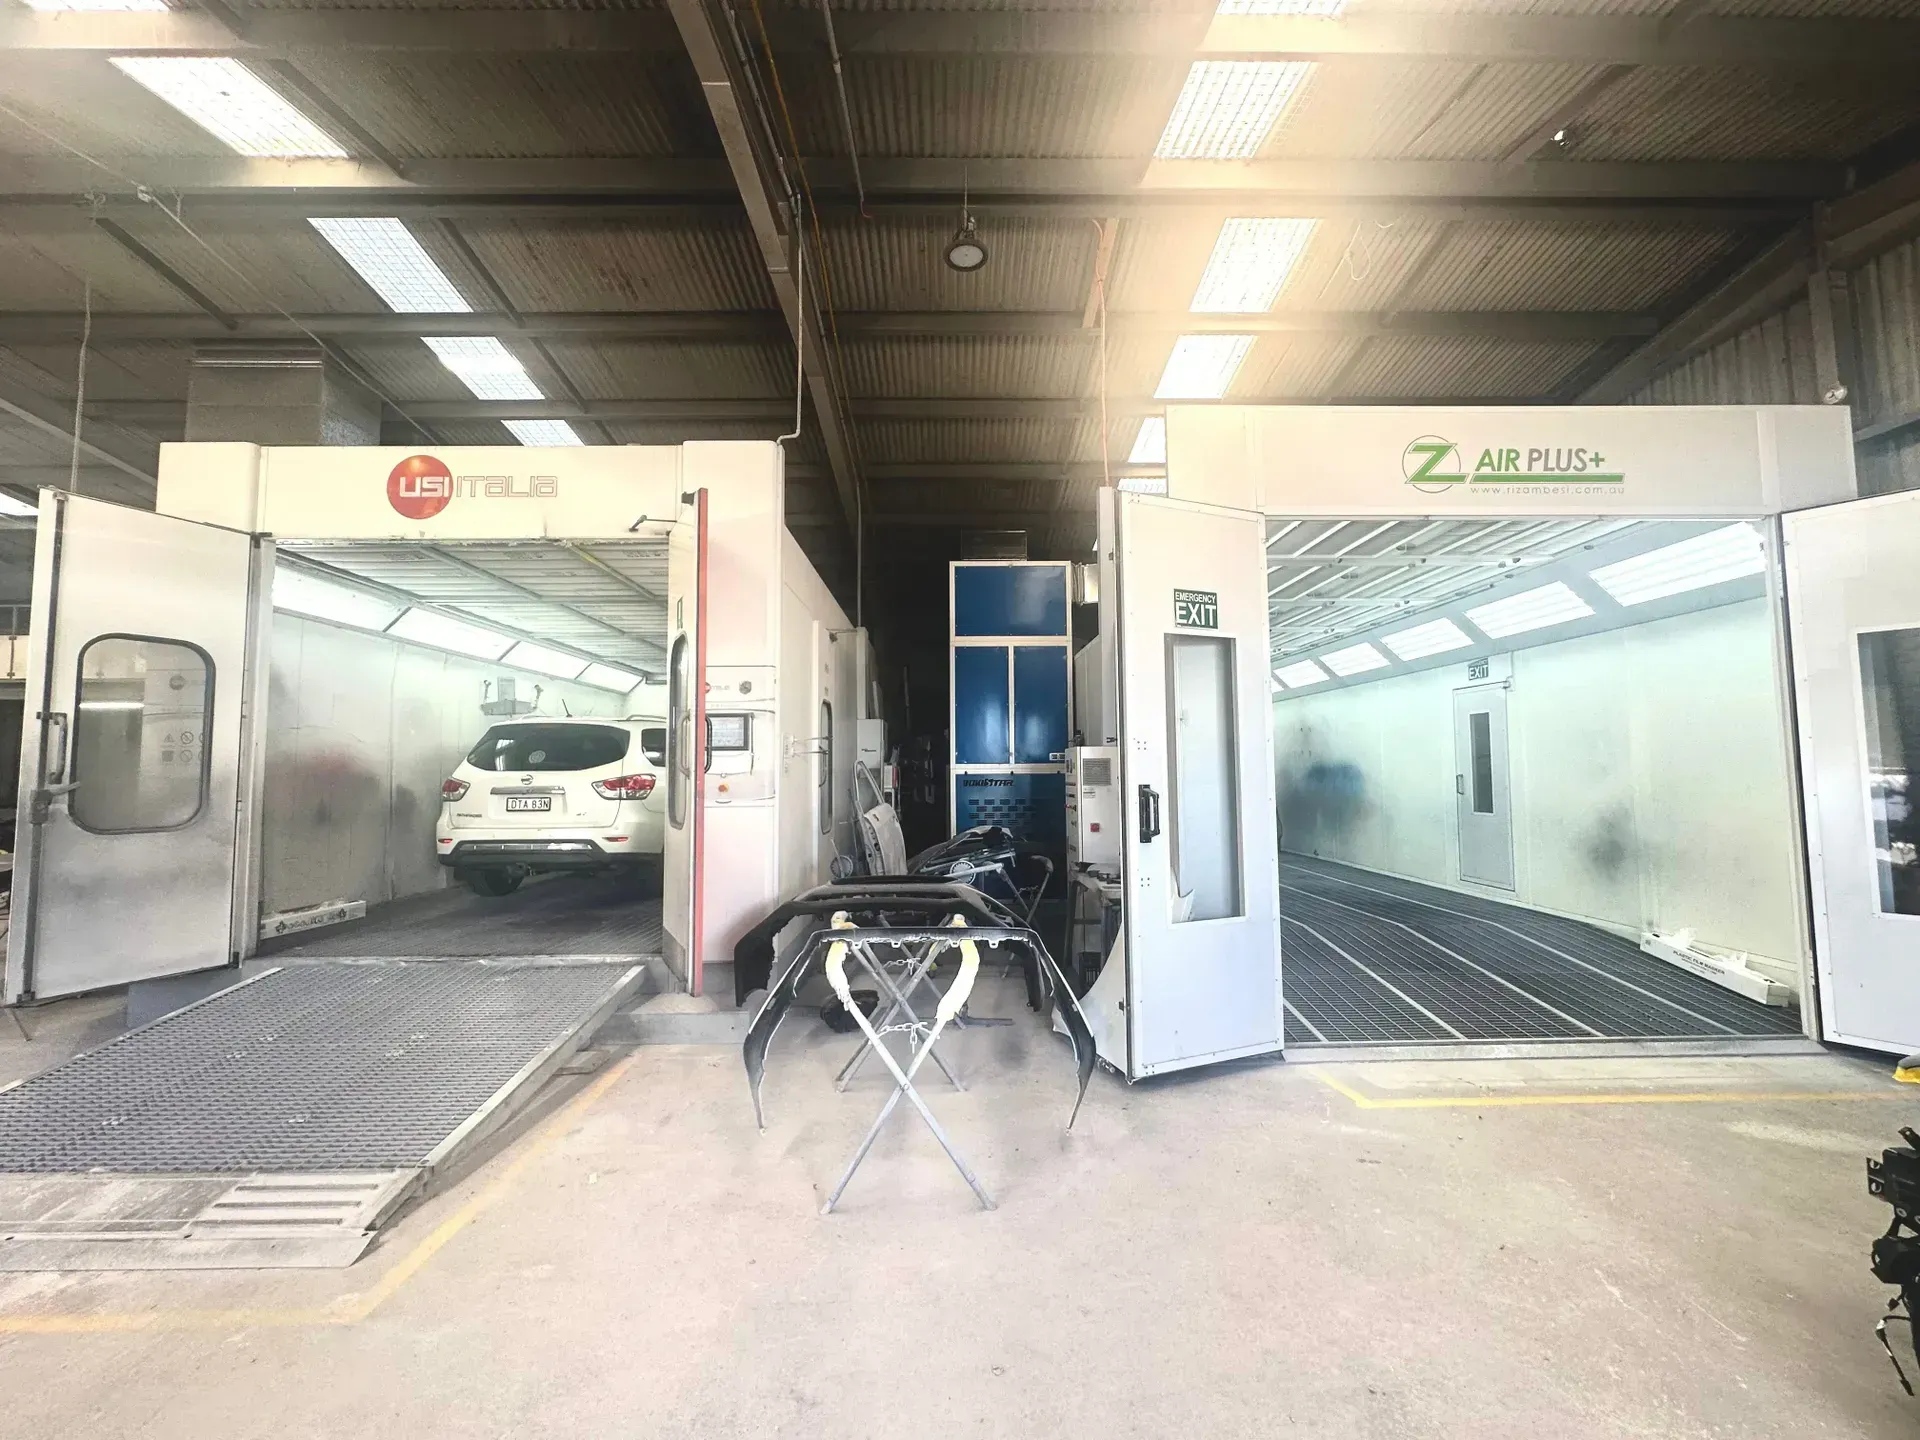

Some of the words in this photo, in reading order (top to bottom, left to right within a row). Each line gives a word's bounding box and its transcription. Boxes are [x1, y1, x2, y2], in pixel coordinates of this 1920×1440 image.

[1474, 448, 1521, 472] AIR
[399, 476, 449, 498] USI
[1175, 591, 1216, 604] EMERGENCY
[1175, 602, 1217, 626] EXIT
[1469, 664, 1488, 680] EXIT
